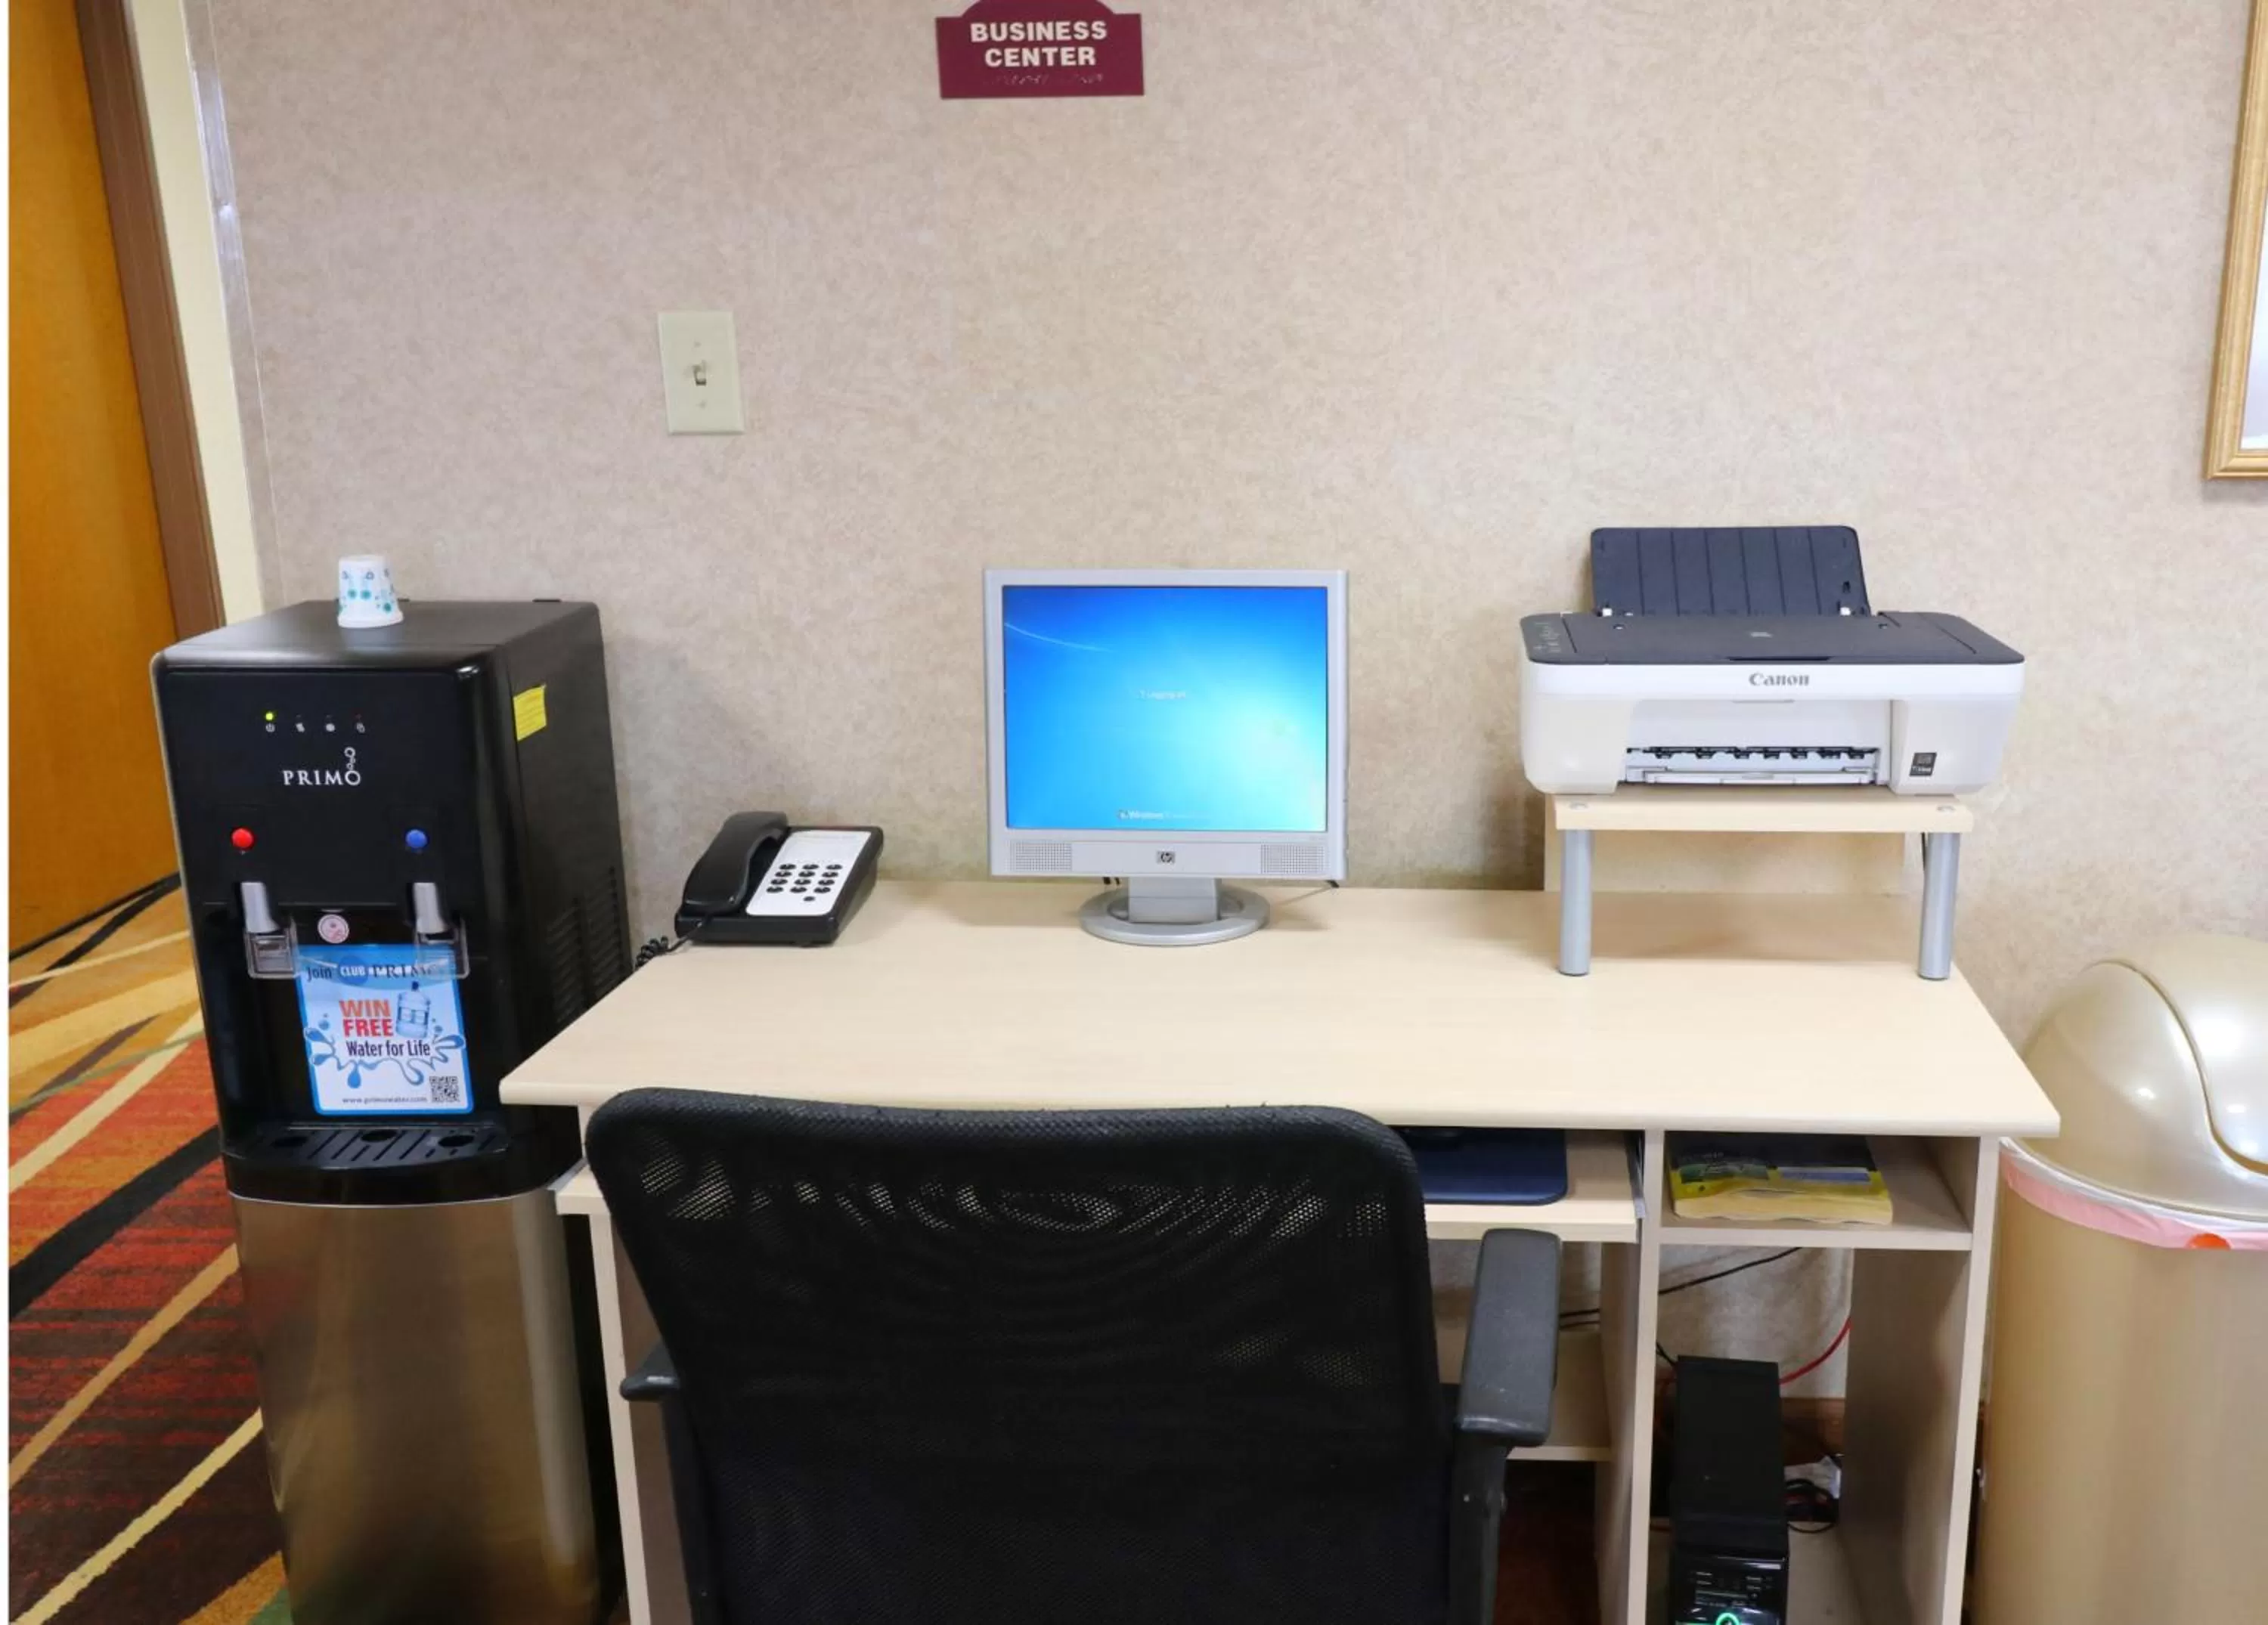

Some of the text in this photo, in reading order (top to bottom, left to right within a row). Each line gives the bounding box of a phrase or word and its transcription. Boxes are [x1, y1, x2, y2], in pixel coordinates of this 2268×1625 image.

[970, 21, 1108, 42] BUSINESS
[984, 46, 1096, 67] CENTER
[1749, 672, 1810, 686] Canon
[282, 769, 361, 786] PRIMO
[306, 966, 332, 980] Join
[340, 966, 366, 977] CLUB
[339, 998, 391, 1017] WIN
[342, 1018, 394, 1038] FREE
[345, 1039, 430, 1057] Water for Life
